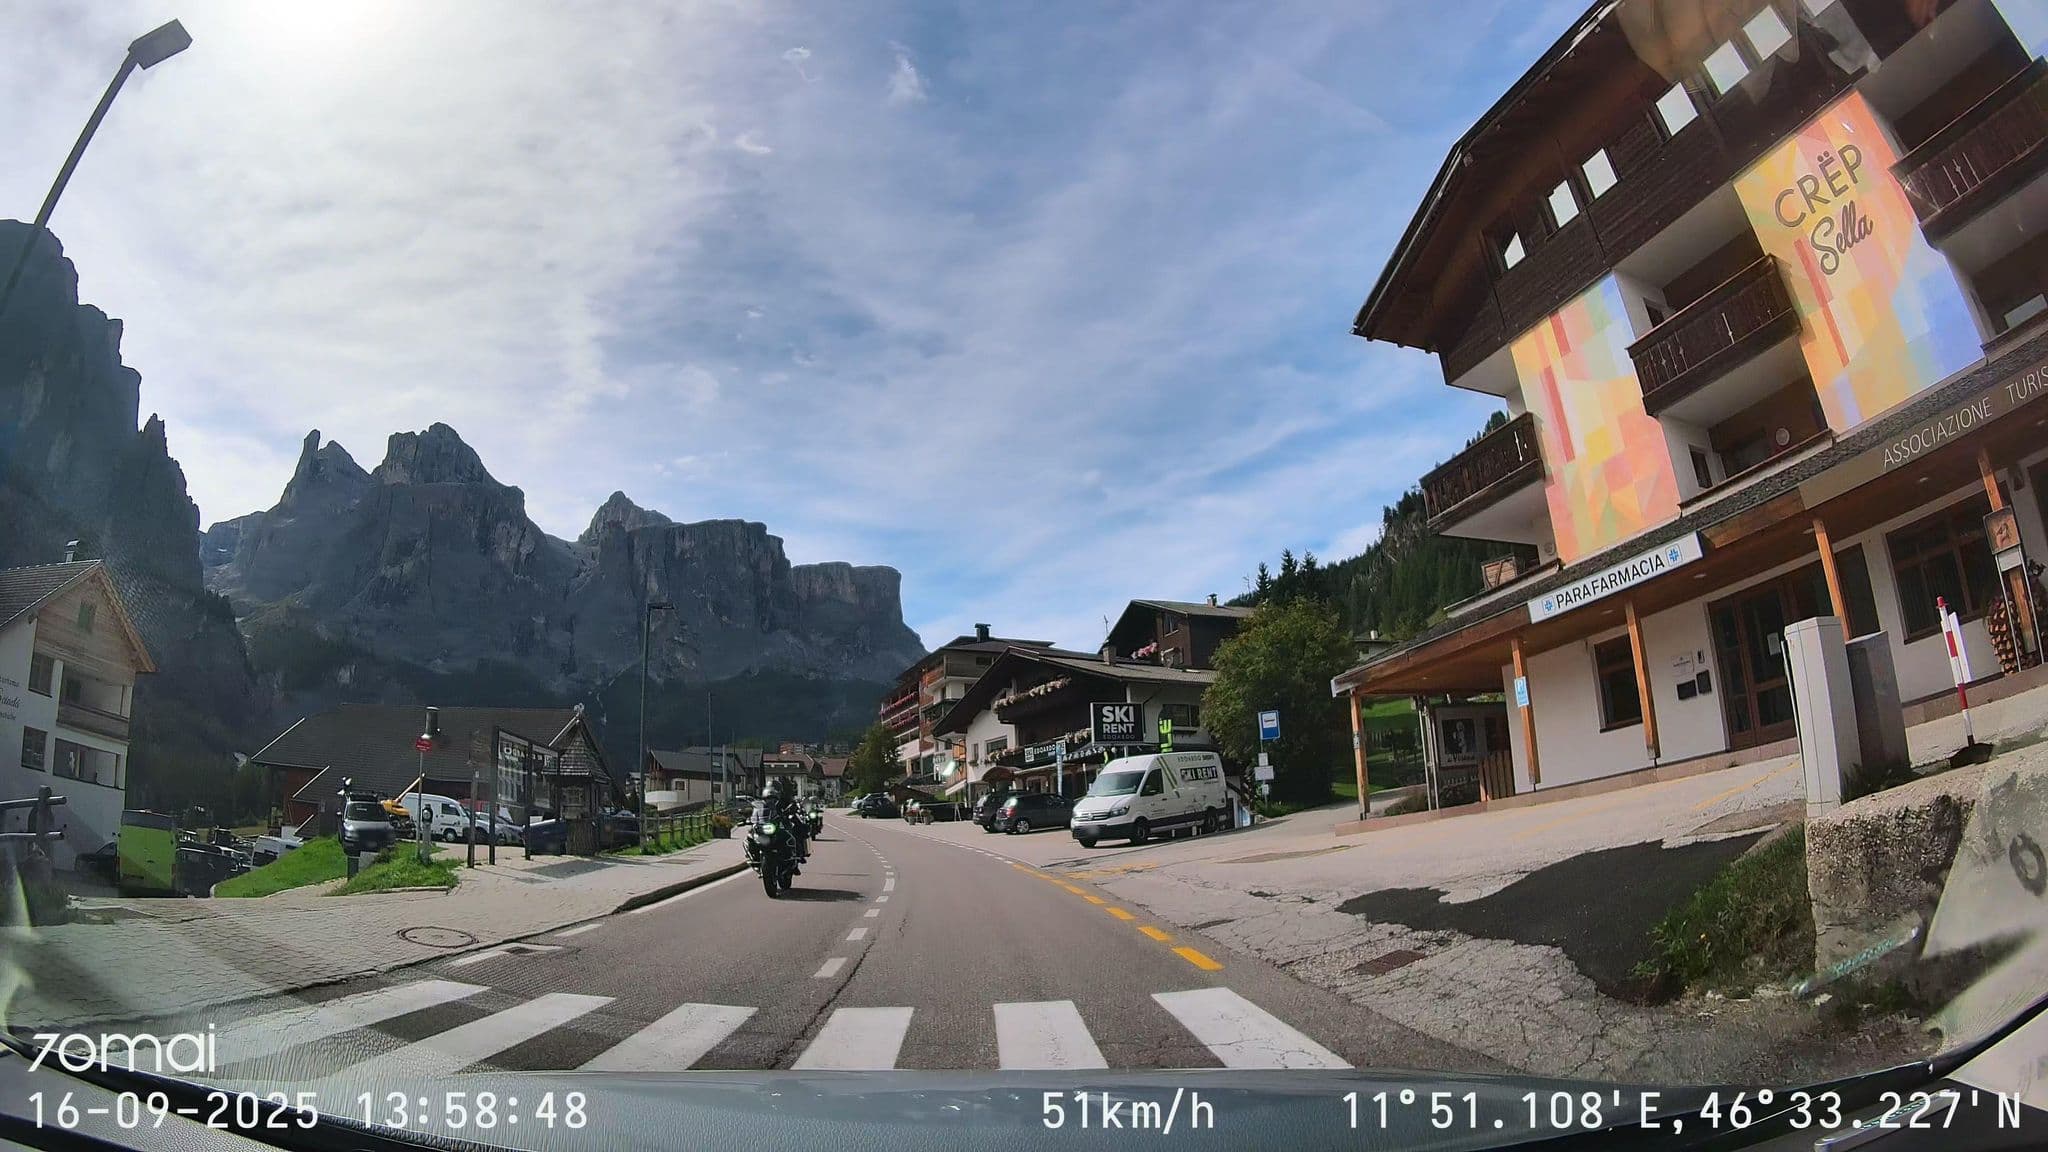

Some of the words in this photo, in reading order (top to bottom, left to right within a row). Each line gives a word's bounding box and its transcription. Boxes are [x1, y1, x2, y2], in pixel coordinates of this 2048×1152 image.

[1775, 144, 1862, 228] CRËP
[1811, 200, 1874, 275] Sella
[1883, 396, 1993, 468] ASSOCIAZIONE
[1555, 554, 1665, 609] PARAFARMACIA
[1102, 705, 1135, 723] SKI
[1102, 723, 1135, 734] RENT
[1196, 767, 1217, 779] RENT
